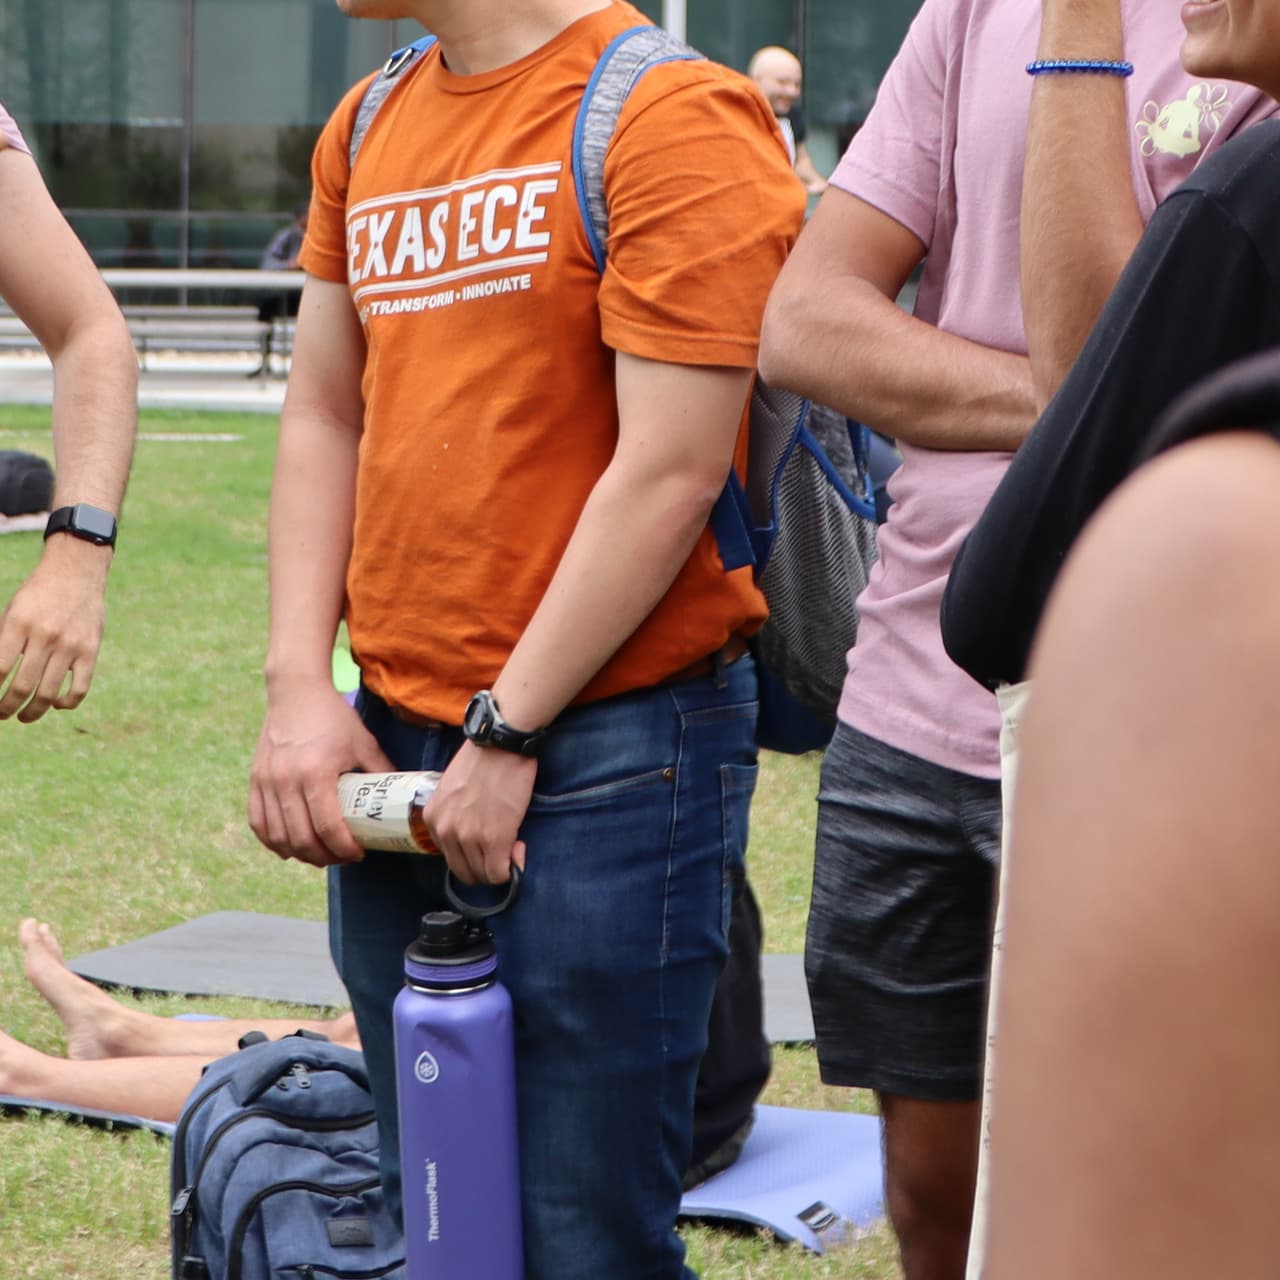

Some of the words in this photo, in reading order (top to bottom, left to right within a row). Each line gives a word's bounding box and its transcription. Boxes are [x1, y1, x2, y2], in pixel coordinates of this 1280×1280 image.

[347, 202, 450, 285] EXAS
[457, 179, 558, 262] ECE
[371, 290, 455, 316] TRANSFORM
[463, 273, 532, 301] INNOVATE
